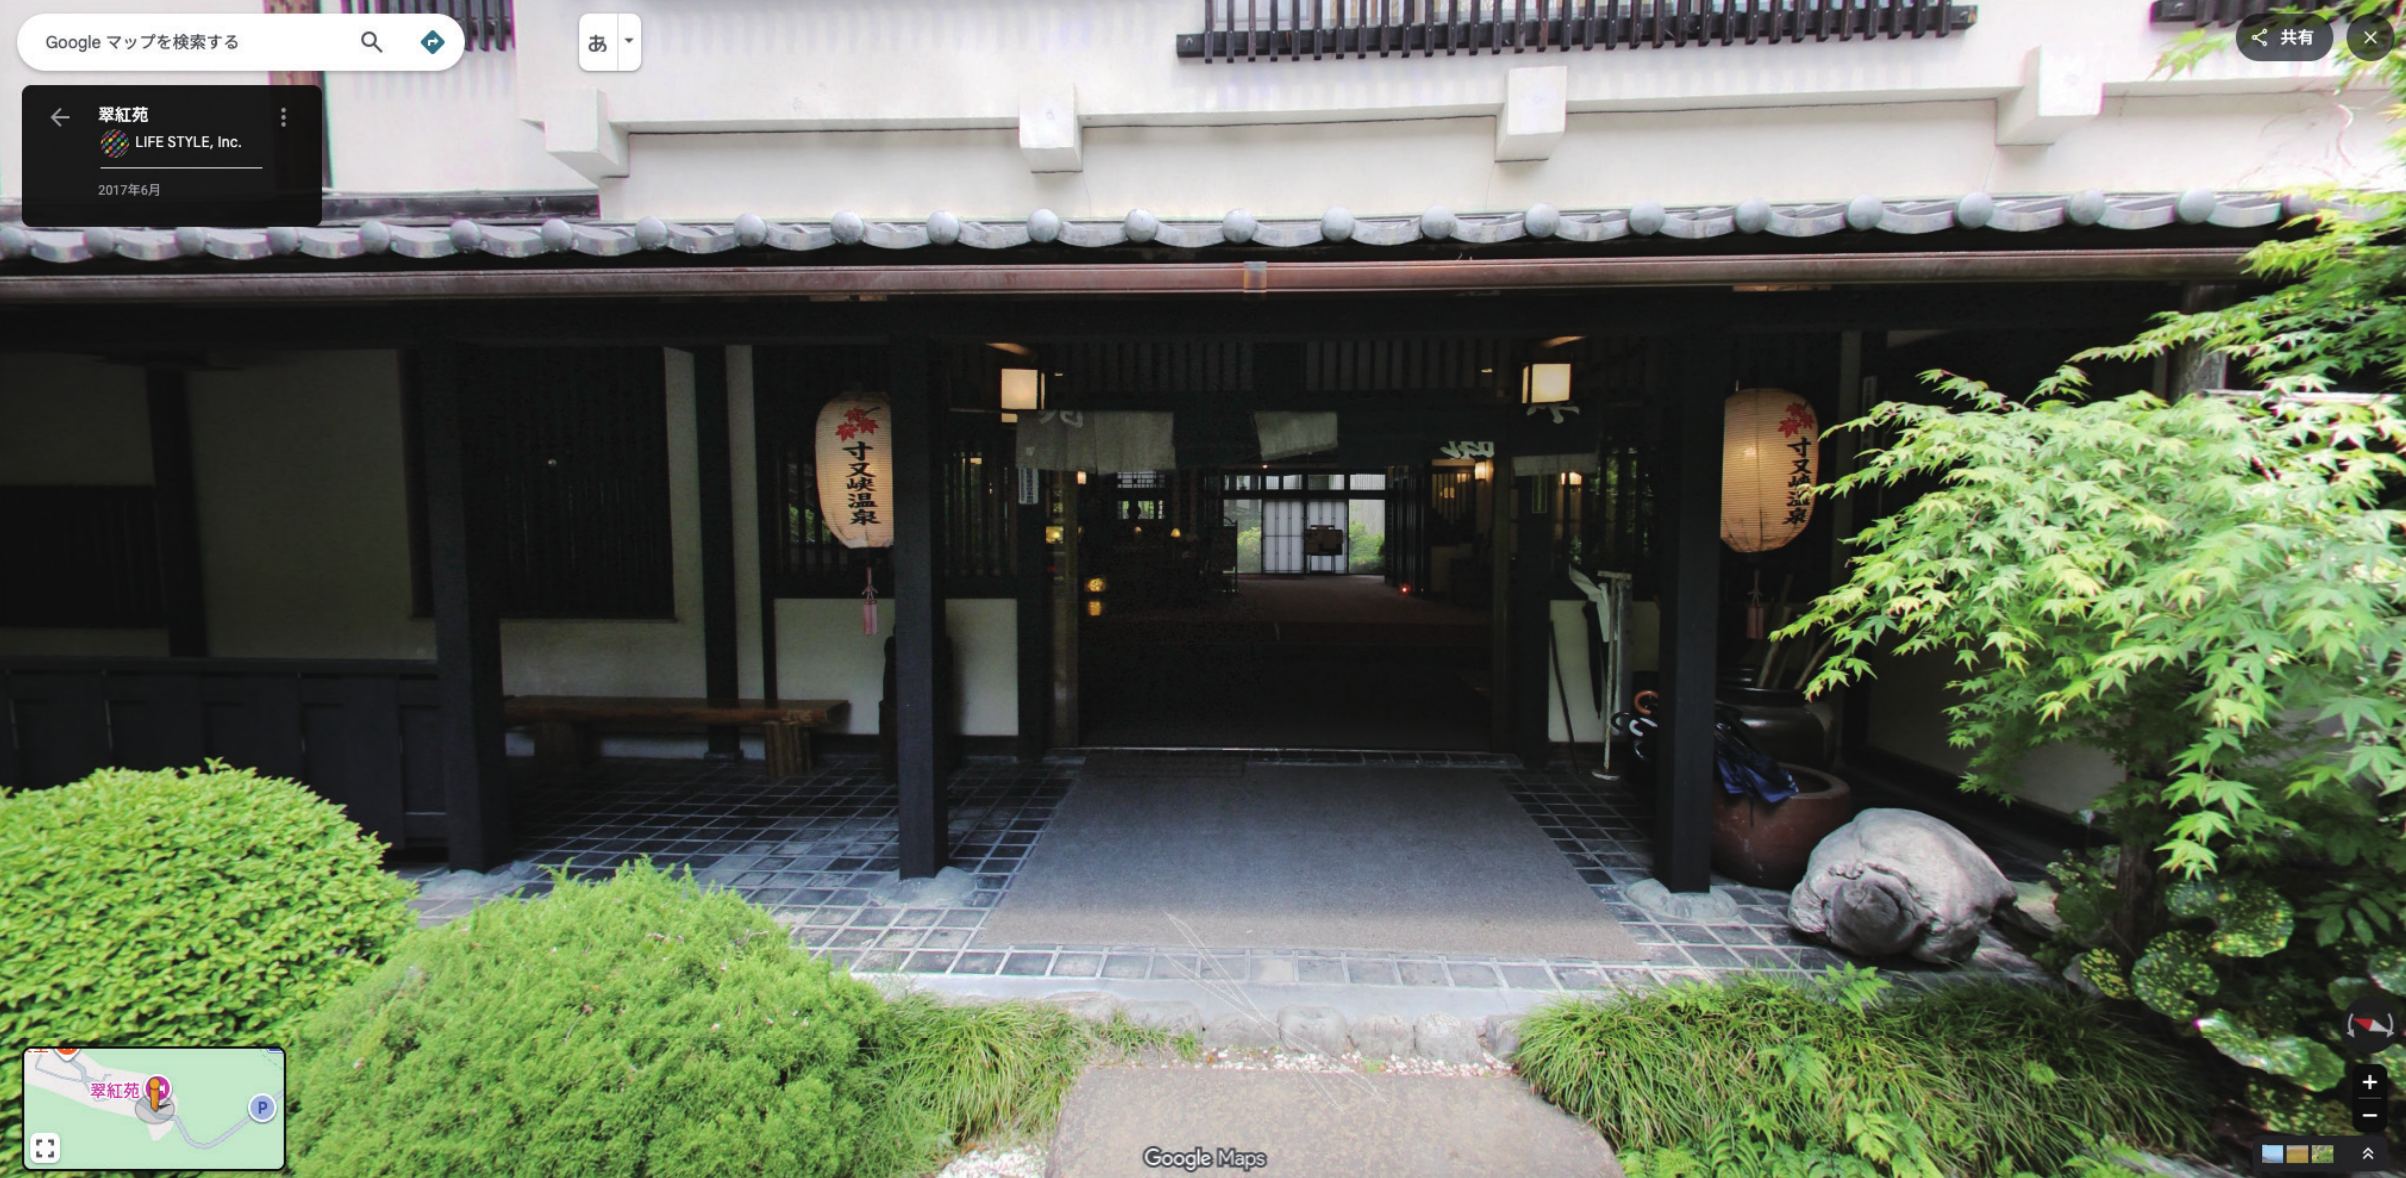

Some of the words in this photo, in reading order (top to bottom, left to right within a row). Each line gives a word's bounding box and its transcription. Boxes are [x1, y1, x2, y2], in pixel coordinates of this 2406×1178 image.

[842, 441, 881, 526] 寸又峡温泉
